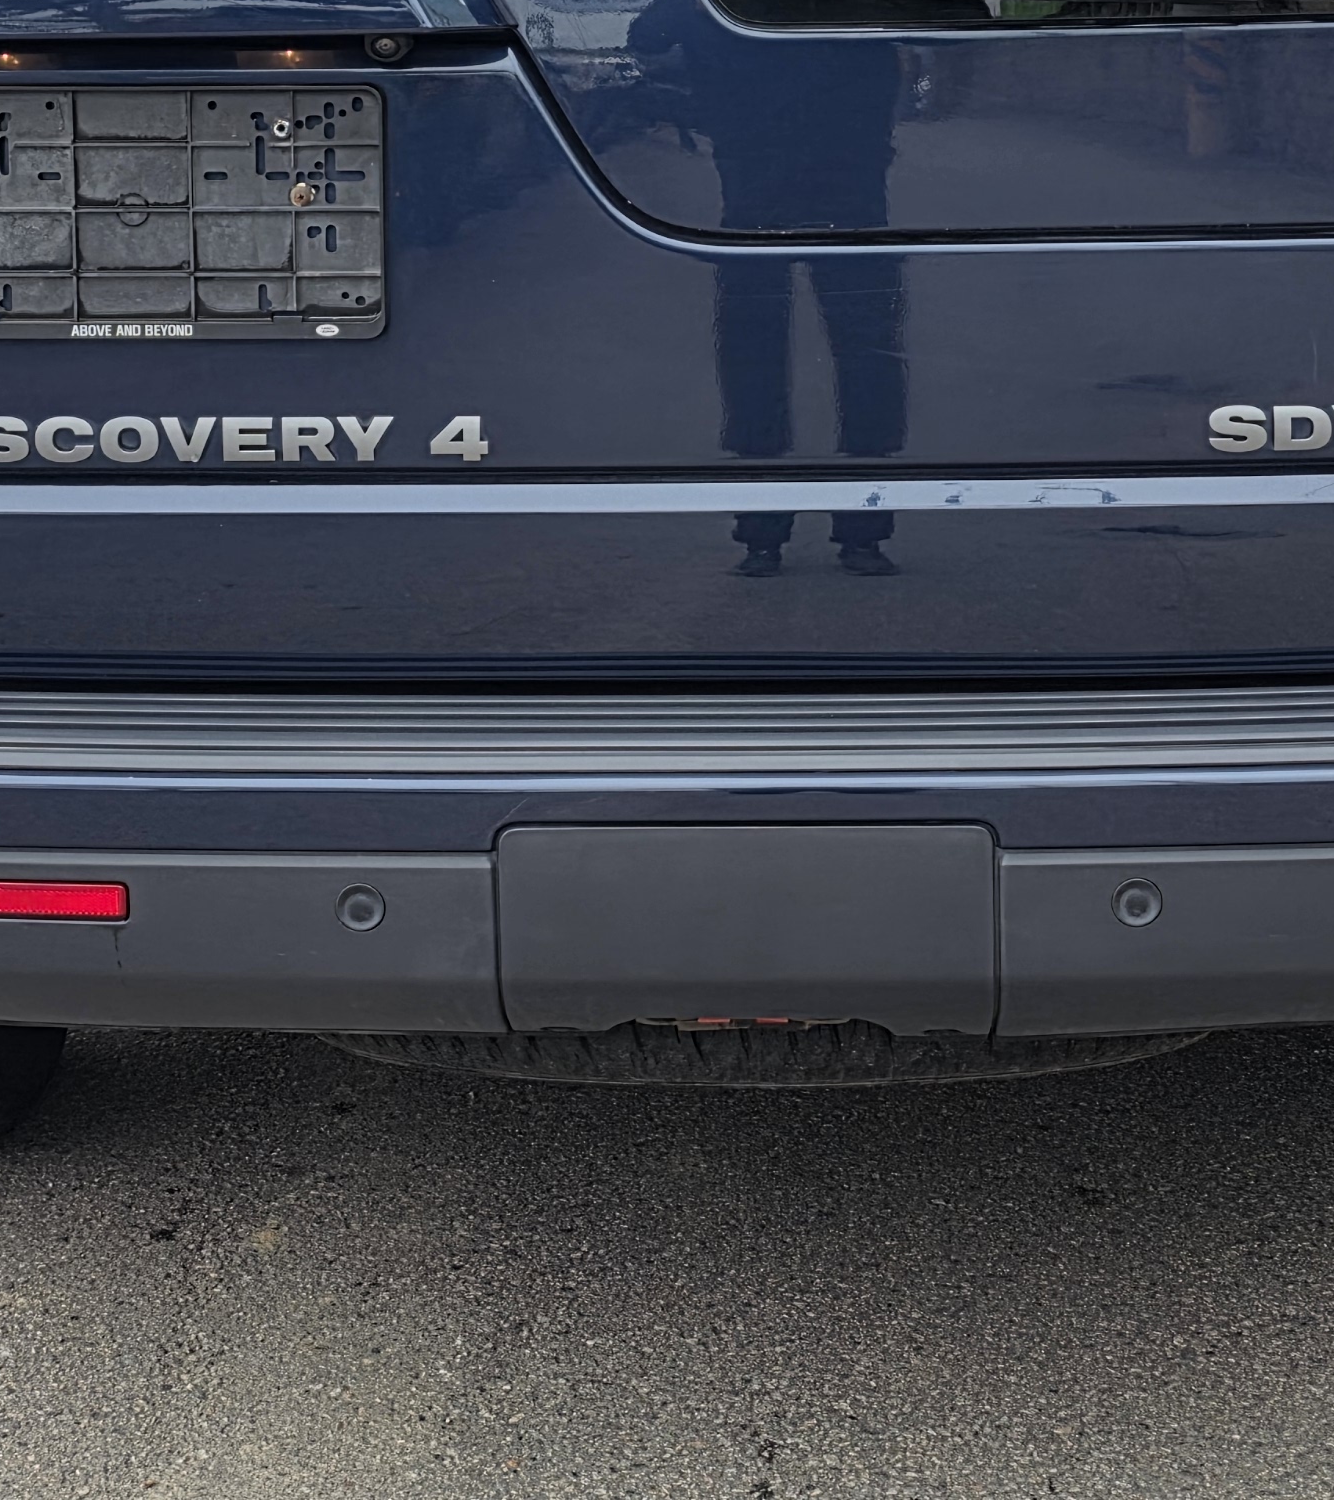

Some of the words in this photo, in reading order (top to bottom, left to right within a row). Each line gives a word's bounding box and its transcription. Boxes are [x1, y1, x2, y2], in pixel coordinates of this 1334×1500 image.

[71, 324, 112, 337] ABOVE
[116, 324, 141, 337] AND
[145, 324, 193, 337] BEYOND
[430, 416, 488, 463] 4
